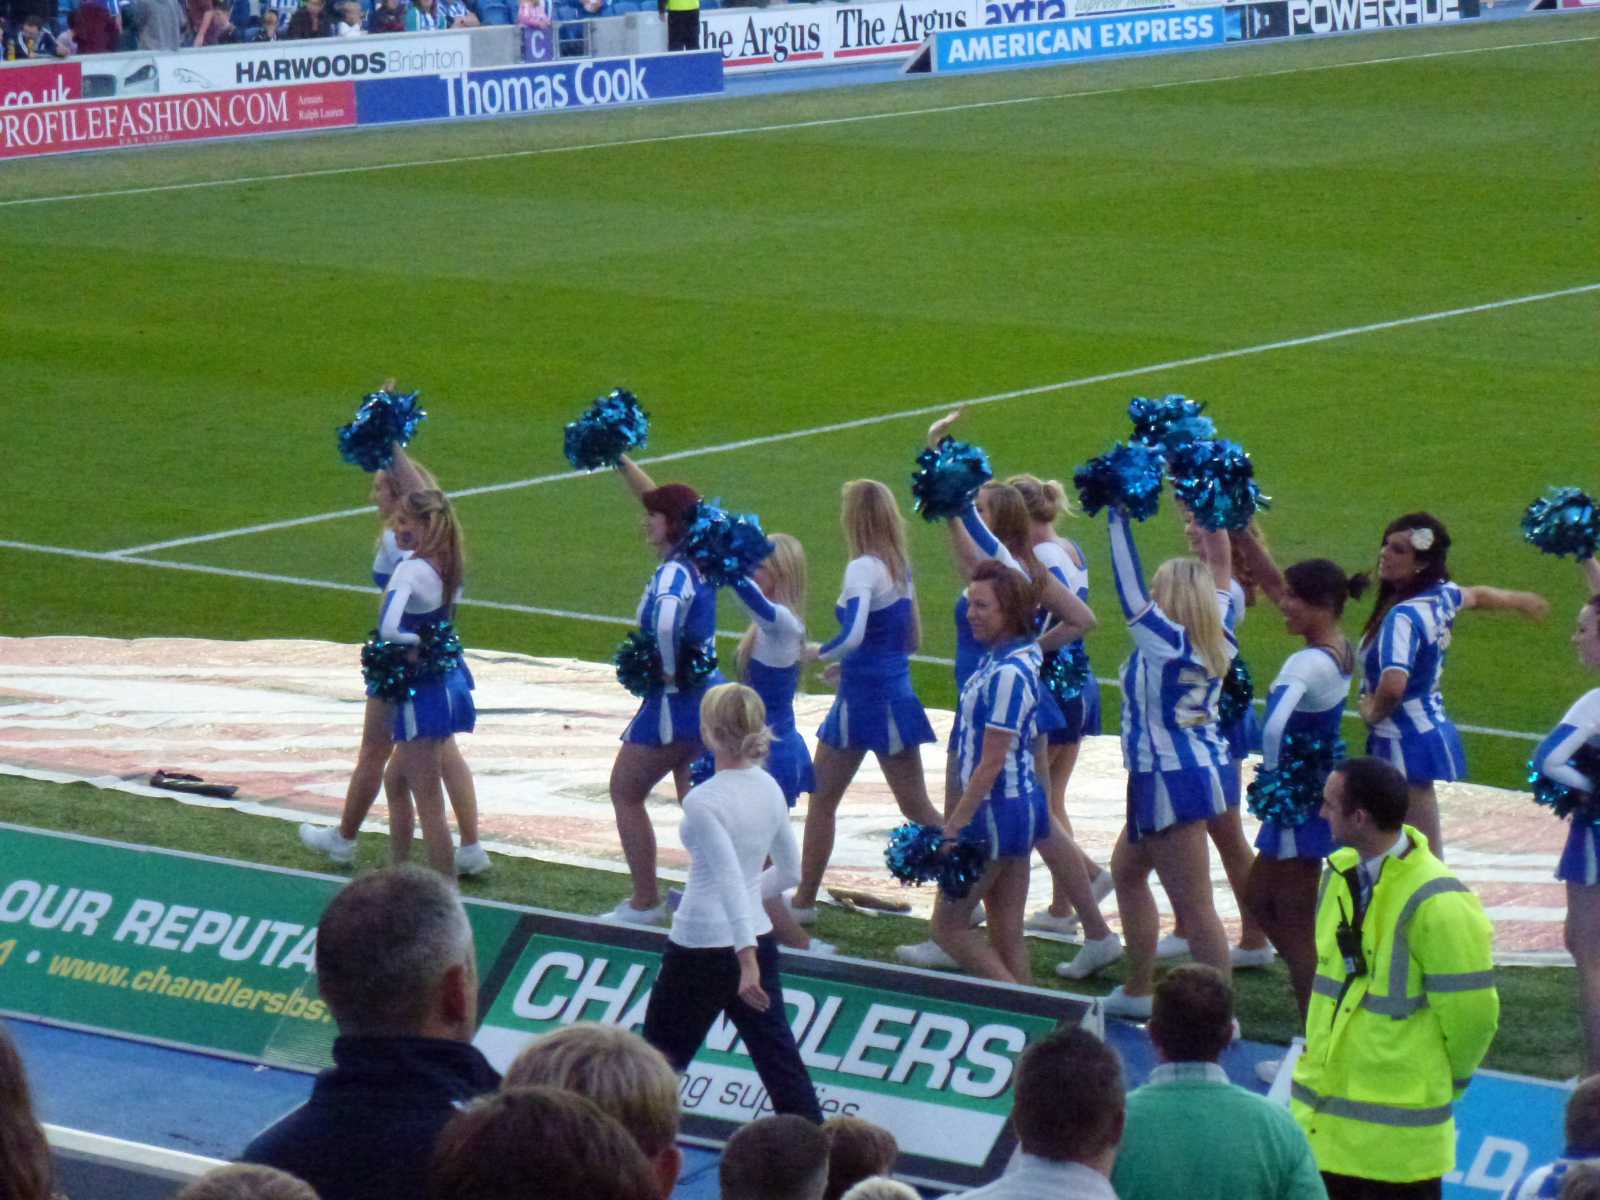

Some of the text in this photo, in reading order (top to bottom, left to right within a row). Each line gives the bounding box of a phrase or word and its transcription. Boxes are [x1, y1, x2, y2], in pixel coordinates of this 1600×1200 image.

[700, 15, 821, 63] he Argus
[836, 8, 885, 49] The
[948, 14, 1214, 64] AMERICAN EXPRESS
[1288, 0, 1461, 36] POWERADE
[236, 50, 464, 84] HARWOODS Brighton
[530, 32, 547, 60] C
[439, 57, 650, 117] Thomas Cook
[0, 91, 289, 148] ROFILEFASHION.COM
[0, 879, 319, 975] OUR REPUTA
[47, 954, 333, 1024] www.chandlersbs.
[512, 951, 1027, 1098] CHDLERS
